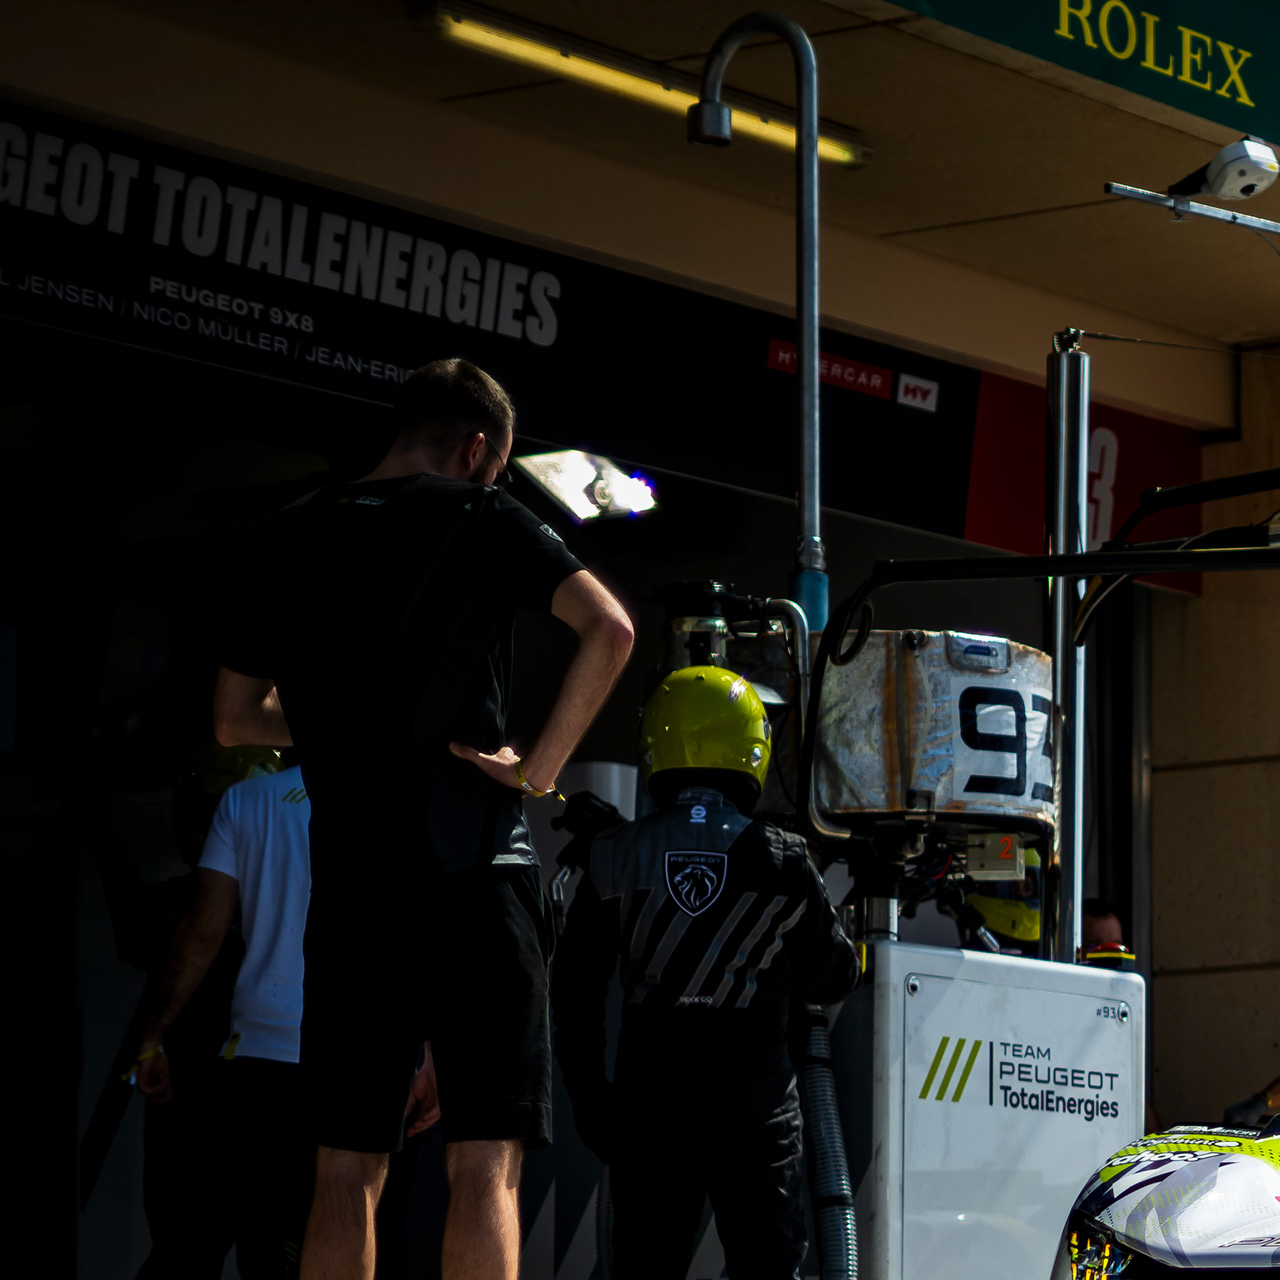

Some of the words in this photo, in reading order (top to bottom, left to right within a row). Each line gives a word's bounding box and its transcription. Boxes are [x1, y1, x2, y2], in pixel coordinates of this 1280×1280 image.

[1054, 0, 1256, 107] ROLEX
[152, 164, 562, 349] TOTALENERGIES
[17, 273, 115, 313] JENSEN
[132, 301, 191, 331] NICO
[198, 318, 289, 356] MÜLLER
[149, 275, 265, 321] PEUGEOT
[269, 306, 315, 334] 9X8
[777, 348, 884, 390] HERCAR
[903, 383, 932, 401] HY
[670, 856, 722, 864] PEUGEOT
[999, 836, 1013, 859] 2
[1096, 1006, 1116, 1019] #93
[1000, 1042, 1050, 1060] TEAM
[1000, 1062, 1119, 1091] PEUGEOT
[1000, 1085, 1119, 1121] TotalEnergies
